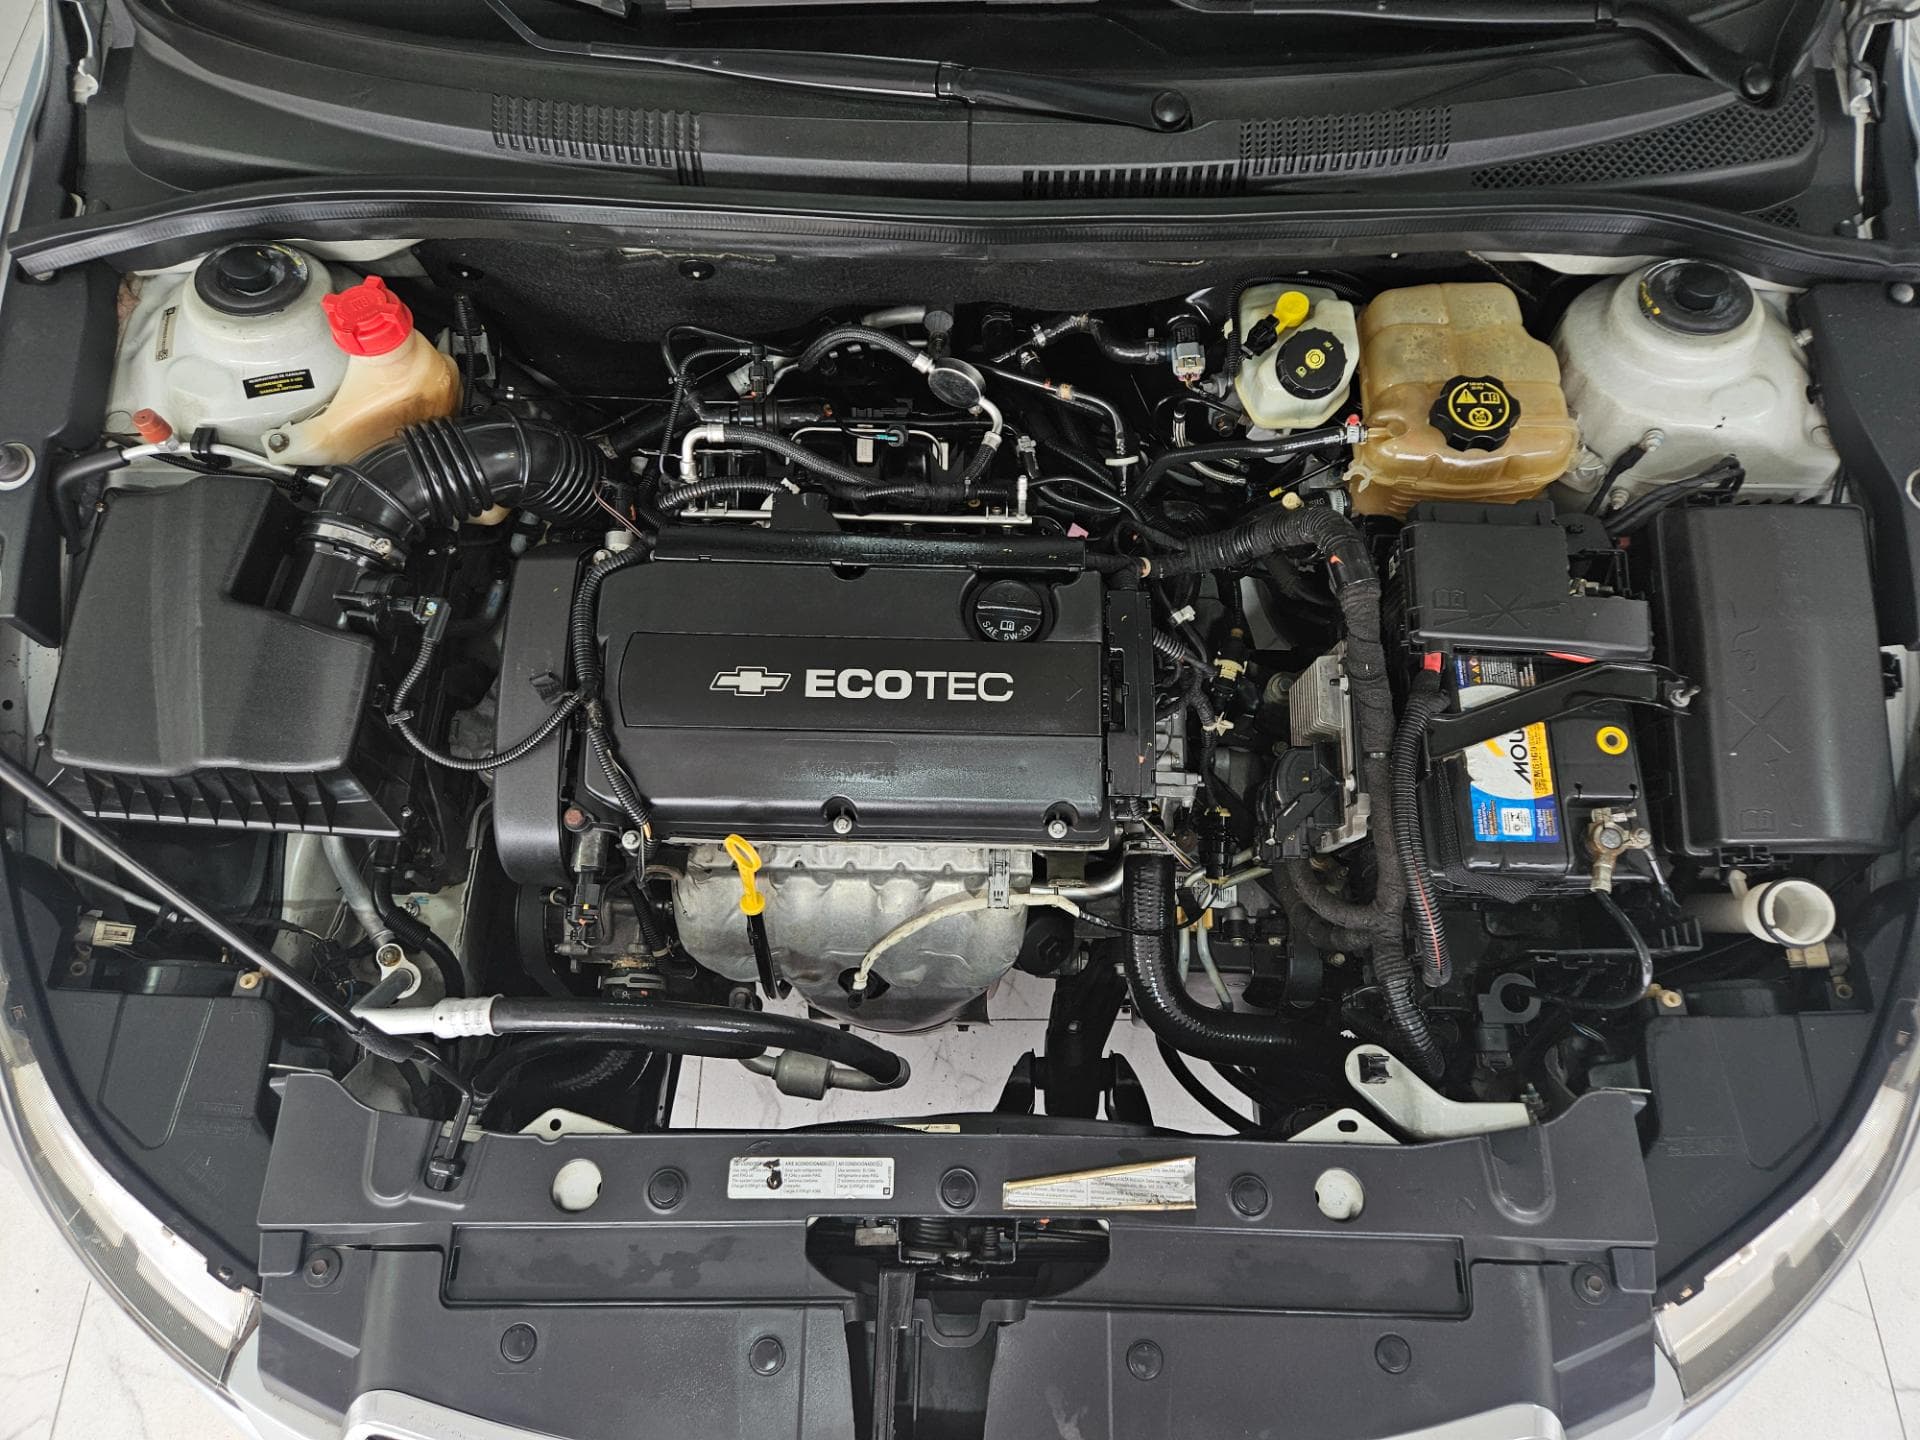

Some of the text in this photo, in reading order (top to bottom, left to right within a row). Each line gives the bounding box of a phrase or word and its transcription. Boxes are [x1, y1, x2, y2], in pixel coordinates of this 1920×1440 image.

[982, 621, 1032, 640] SAE 5W-30
[804, 668, 1015, 703] ECOTEC
